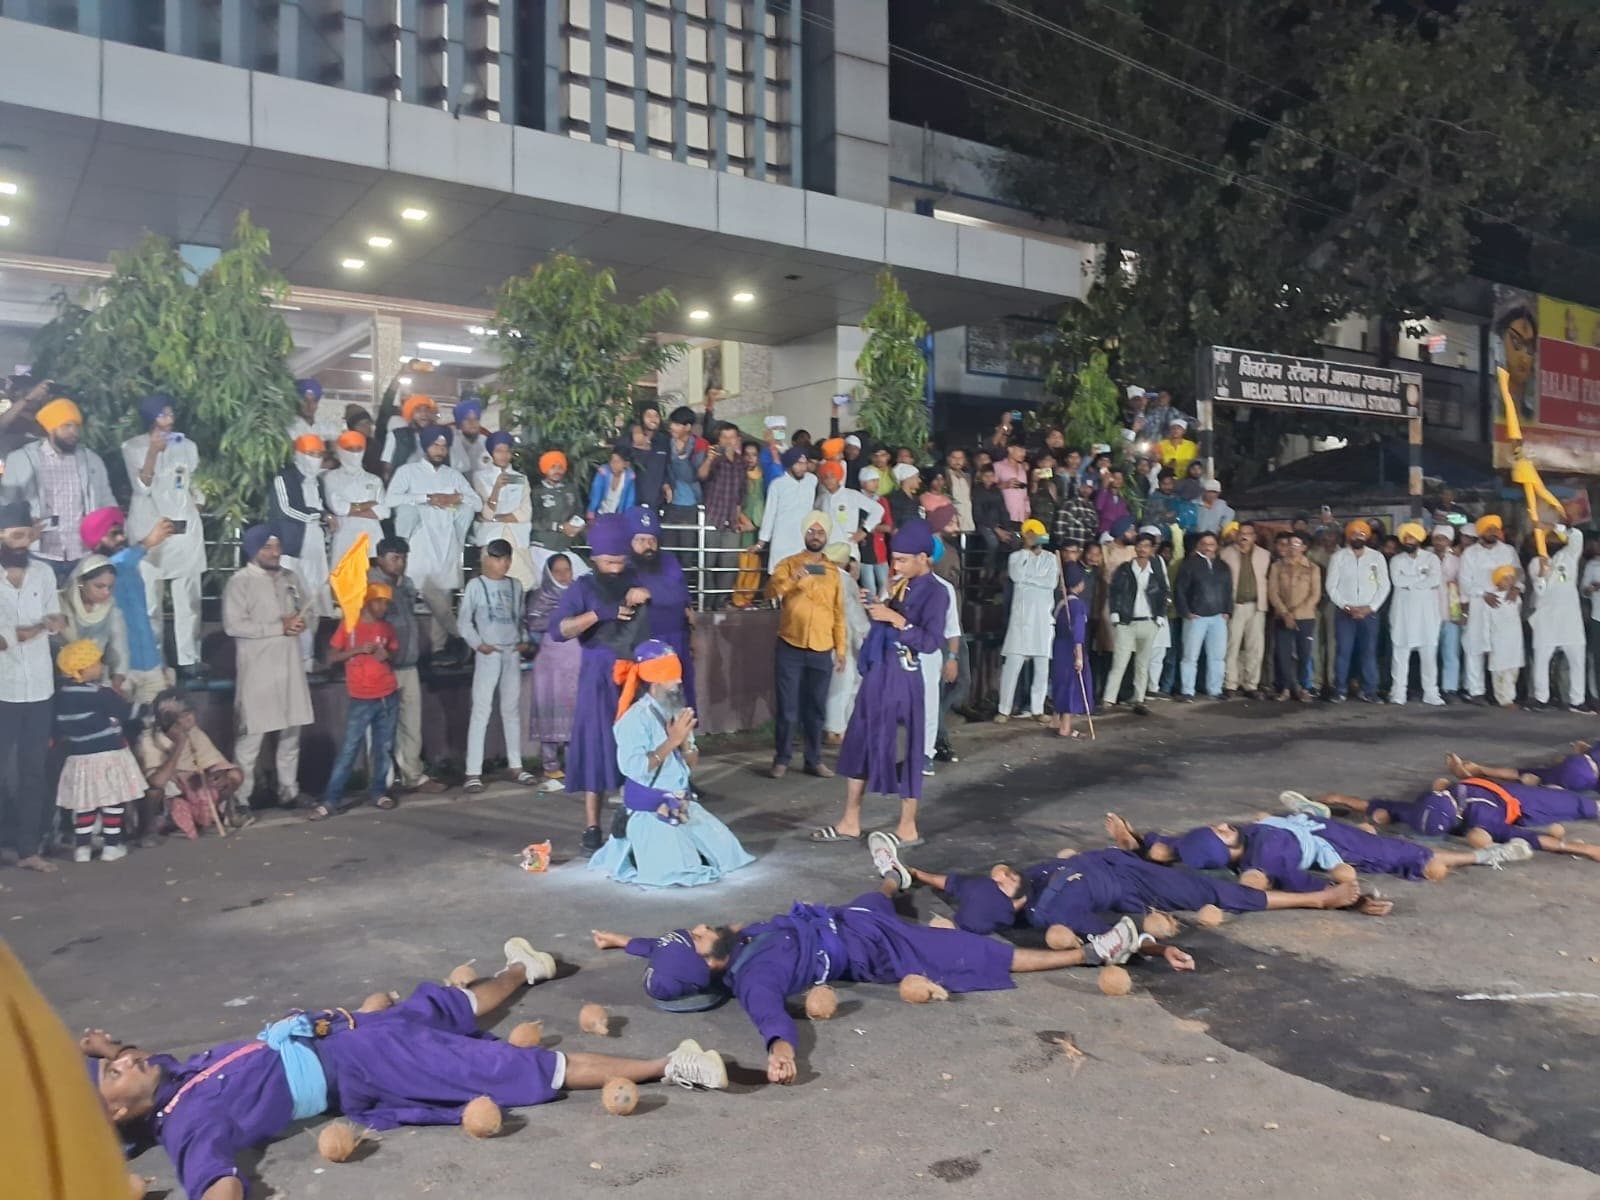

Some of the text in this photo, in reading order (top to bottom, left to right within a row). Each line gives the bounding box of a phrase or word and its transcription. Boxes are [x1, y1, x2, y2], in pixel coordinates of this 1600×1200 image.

[1287, 361, 1318, 383] स्टेशन
[1319, 363, 1330, 384] में
[1329, 370, 1361, 388] आपका
[1362, 374, 1392, 392] स्वागत
[1392, 374, 1401, 394] है
[1240, 381, 1288, 401] WELCOME
[1288, 385, 1302, 402] TO
[1303, 387, 1367, 409] CHITTARANJAN
[1367, 394, 1402, 413] STATION
